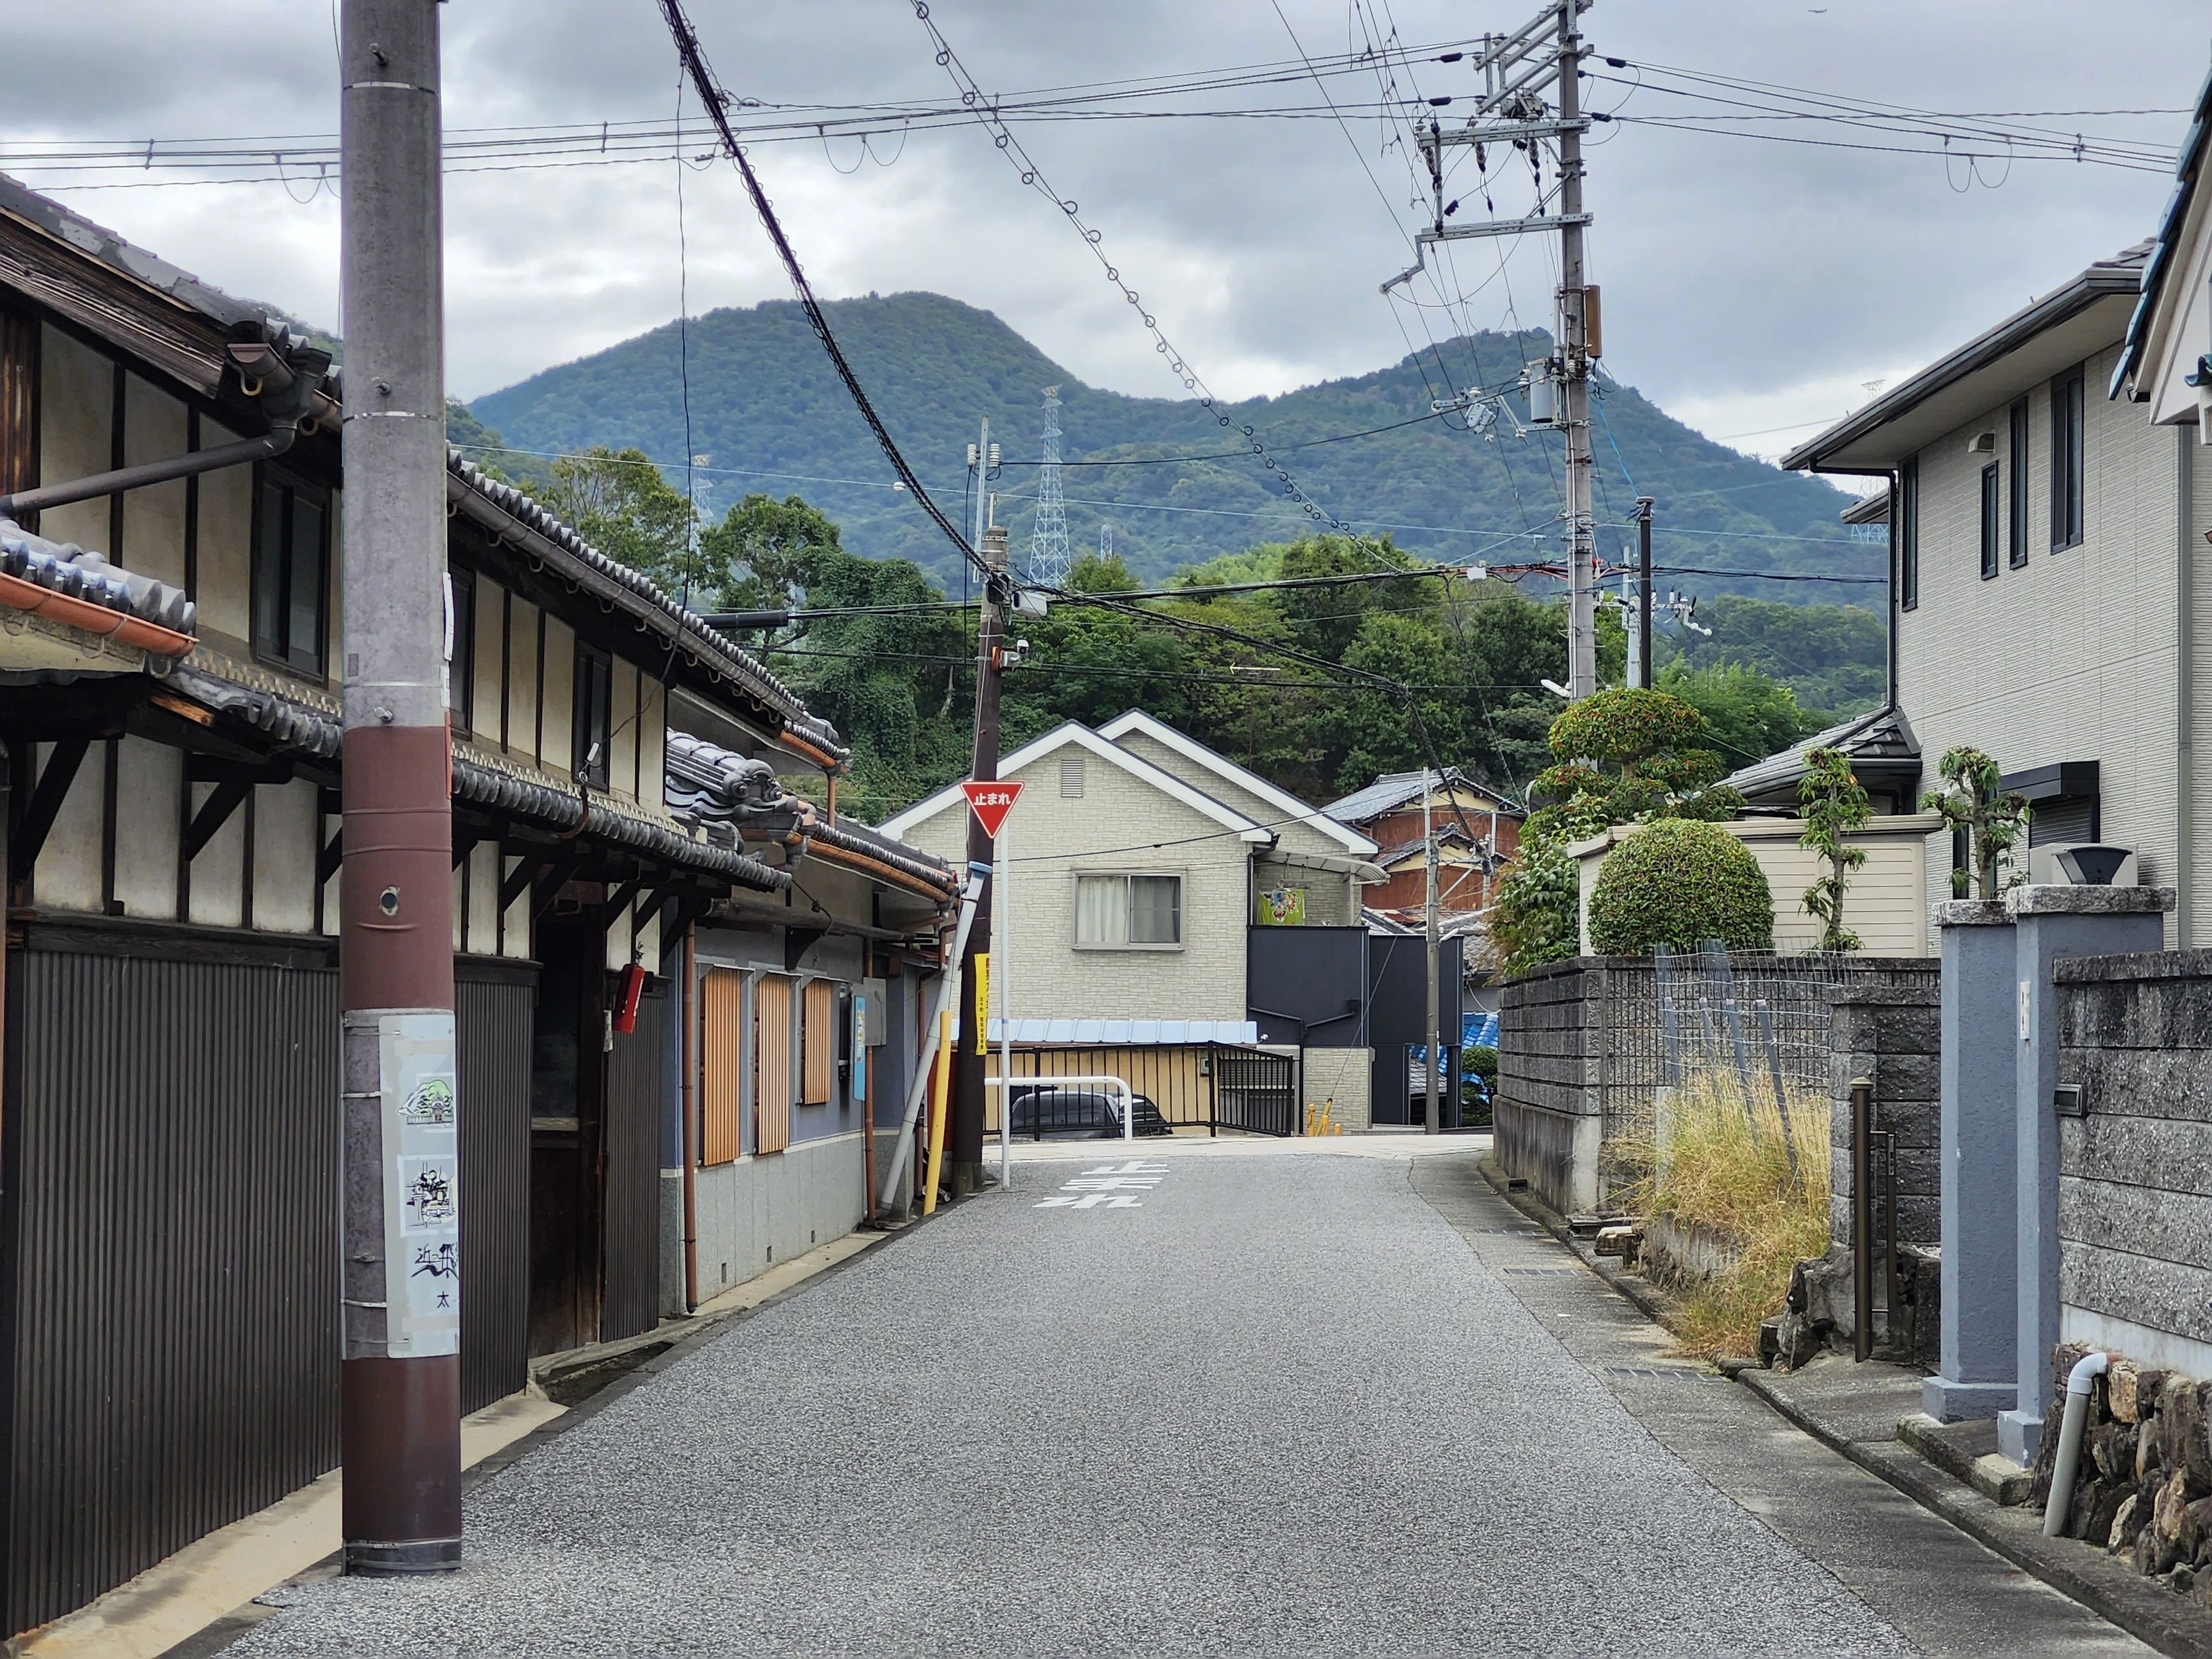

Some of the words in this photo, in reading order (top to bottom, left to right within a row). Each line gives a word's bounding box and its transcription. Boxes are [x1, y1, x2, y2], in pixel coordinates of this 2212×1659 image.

[973, 792, 1011, 806] 止まれ
[1032, 1161, 1170, 1209] 止まれ
